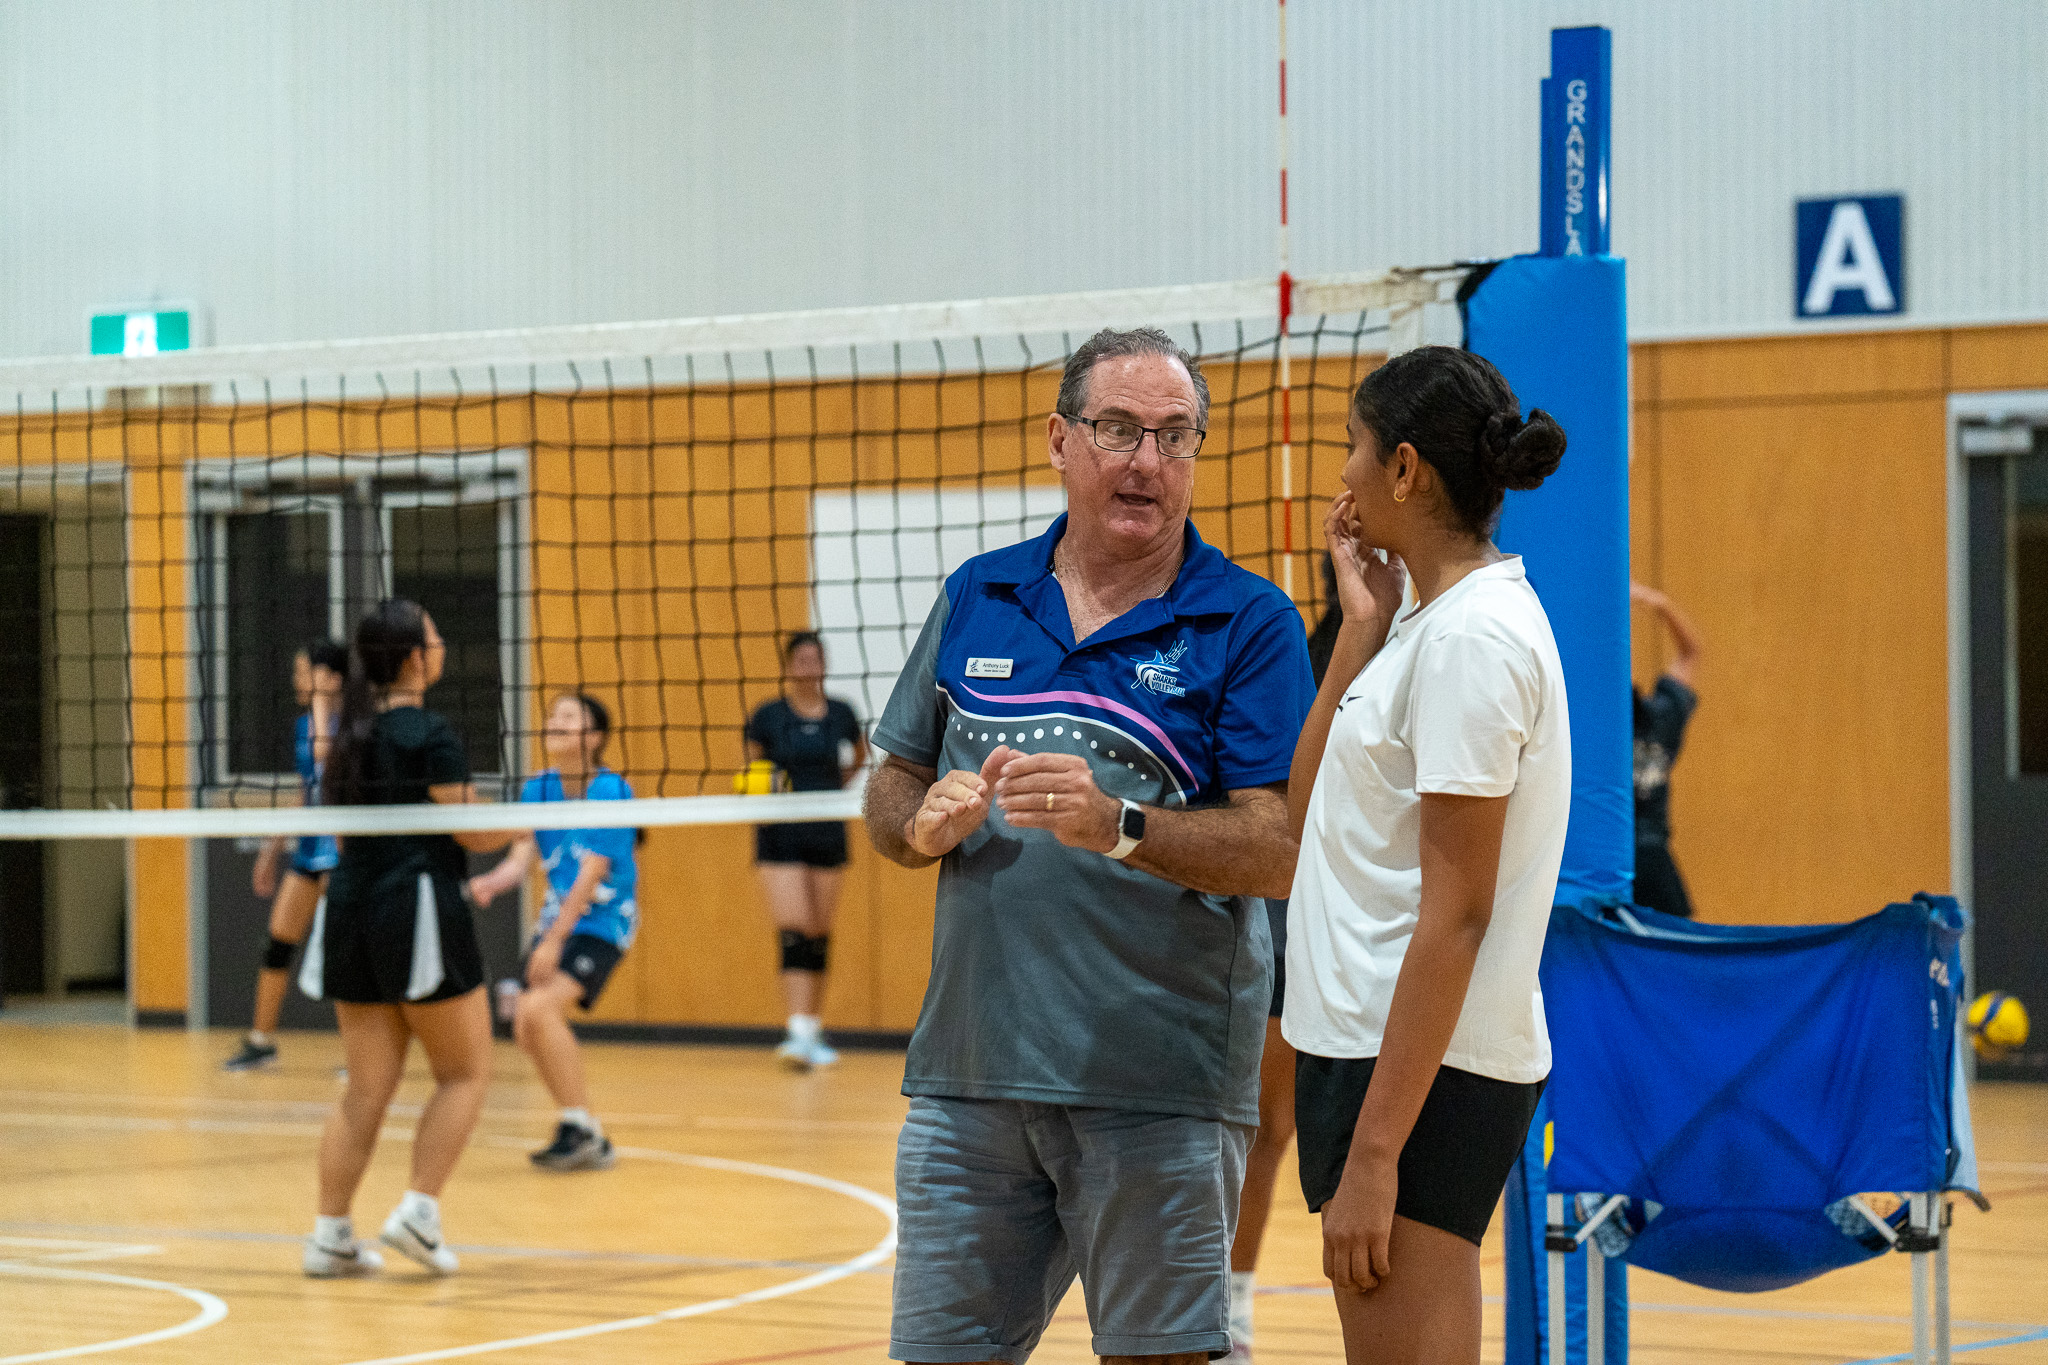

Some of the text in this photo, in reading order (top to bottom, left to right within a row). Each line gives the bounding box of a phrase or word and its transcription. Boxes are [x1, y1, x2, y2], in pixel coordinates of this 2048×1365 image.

[1801, 200, 1897, 314] A
[1152, 672, 1177, 686] SHARKS
[1151, 680, 1186, 697] VOLLEYBALL
